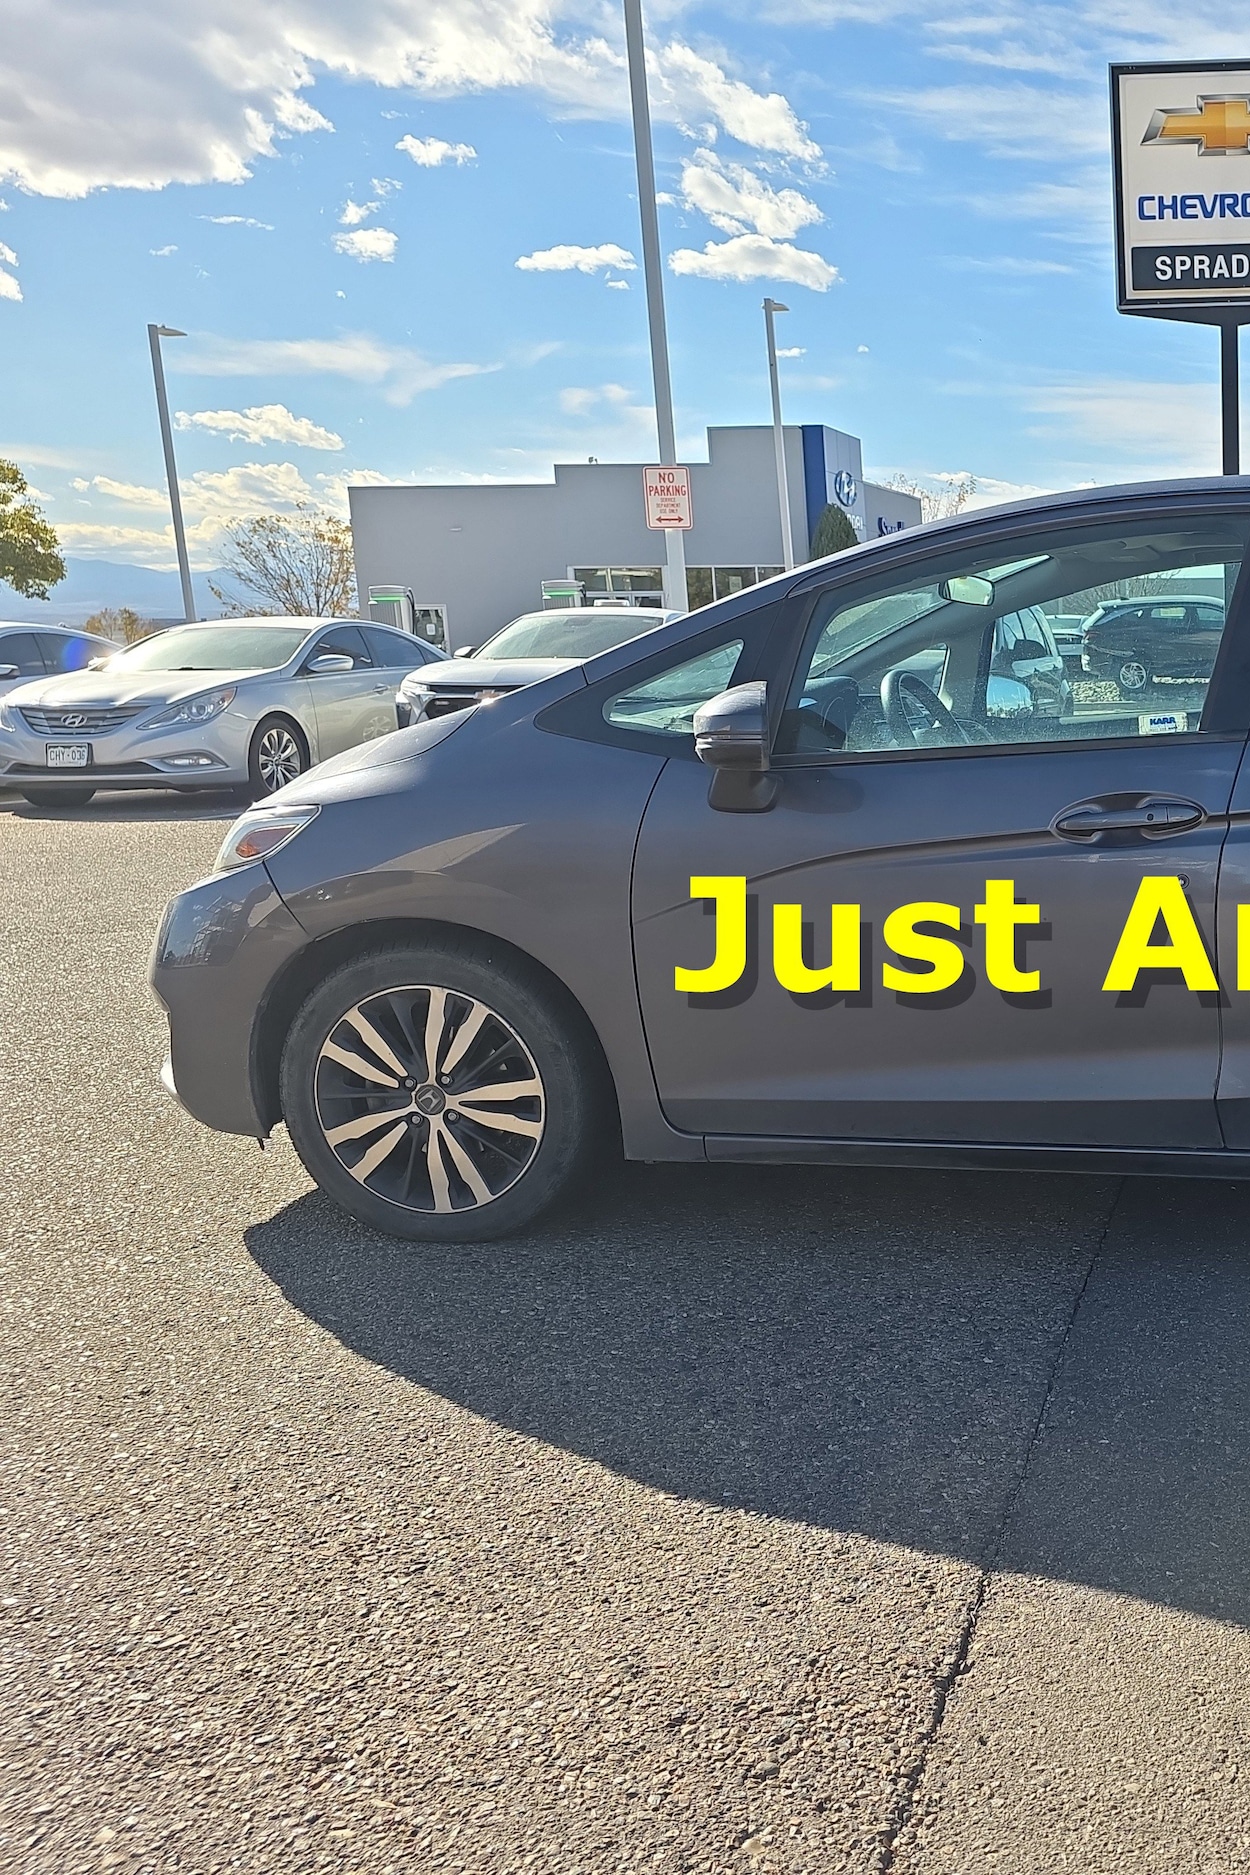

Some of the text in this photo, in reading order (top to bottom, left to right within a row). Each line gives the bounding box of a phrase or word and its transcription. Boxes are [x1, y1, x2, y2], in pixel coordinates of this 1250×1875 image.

[658, 472, 675, 483] NO
[648, 485, 687, 497] PARKING
[1149, 716, 1176, 726] KARR
